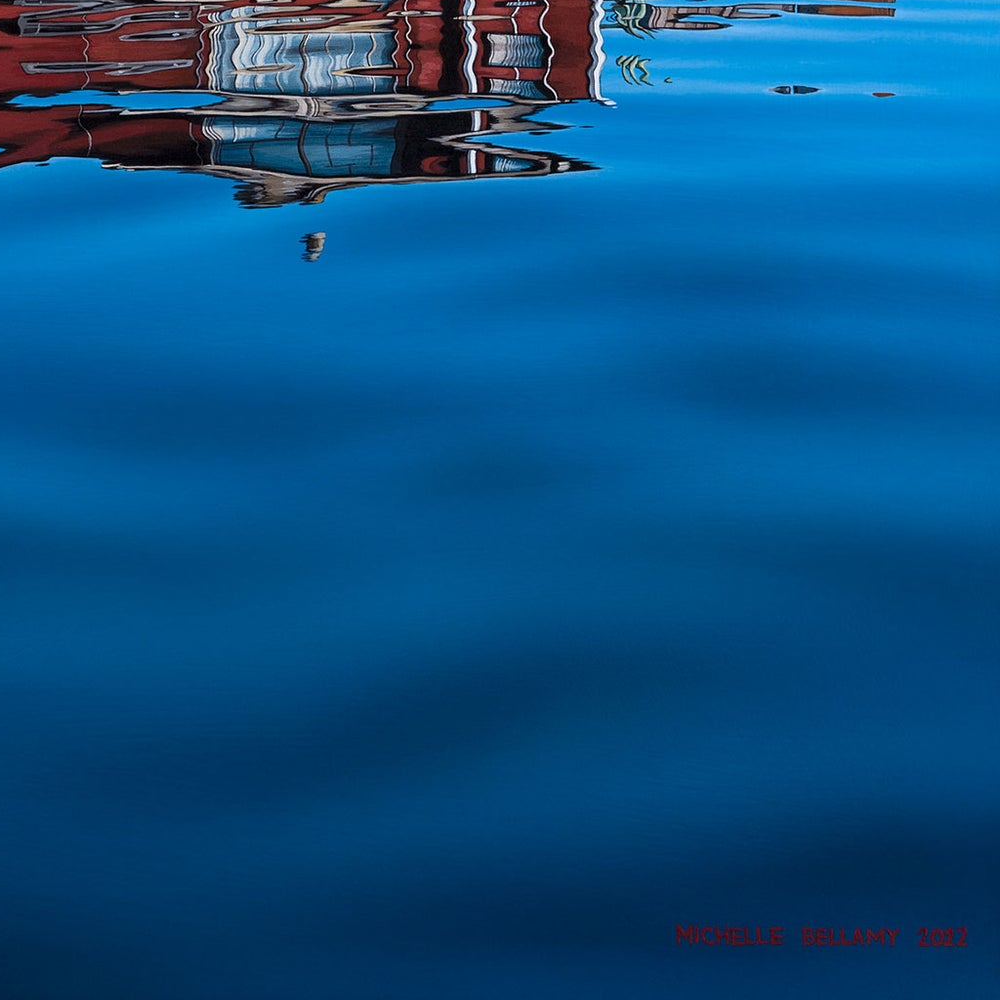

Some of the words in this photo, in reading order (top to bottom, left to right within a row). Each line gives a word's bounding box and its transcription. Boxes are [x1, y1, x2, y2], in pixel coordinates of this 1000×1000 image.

[676, 925, 782, 946] MICHELLE
[802, 927, 898, 946] BELLAMY
[918, 927, 968, 946] 2022
